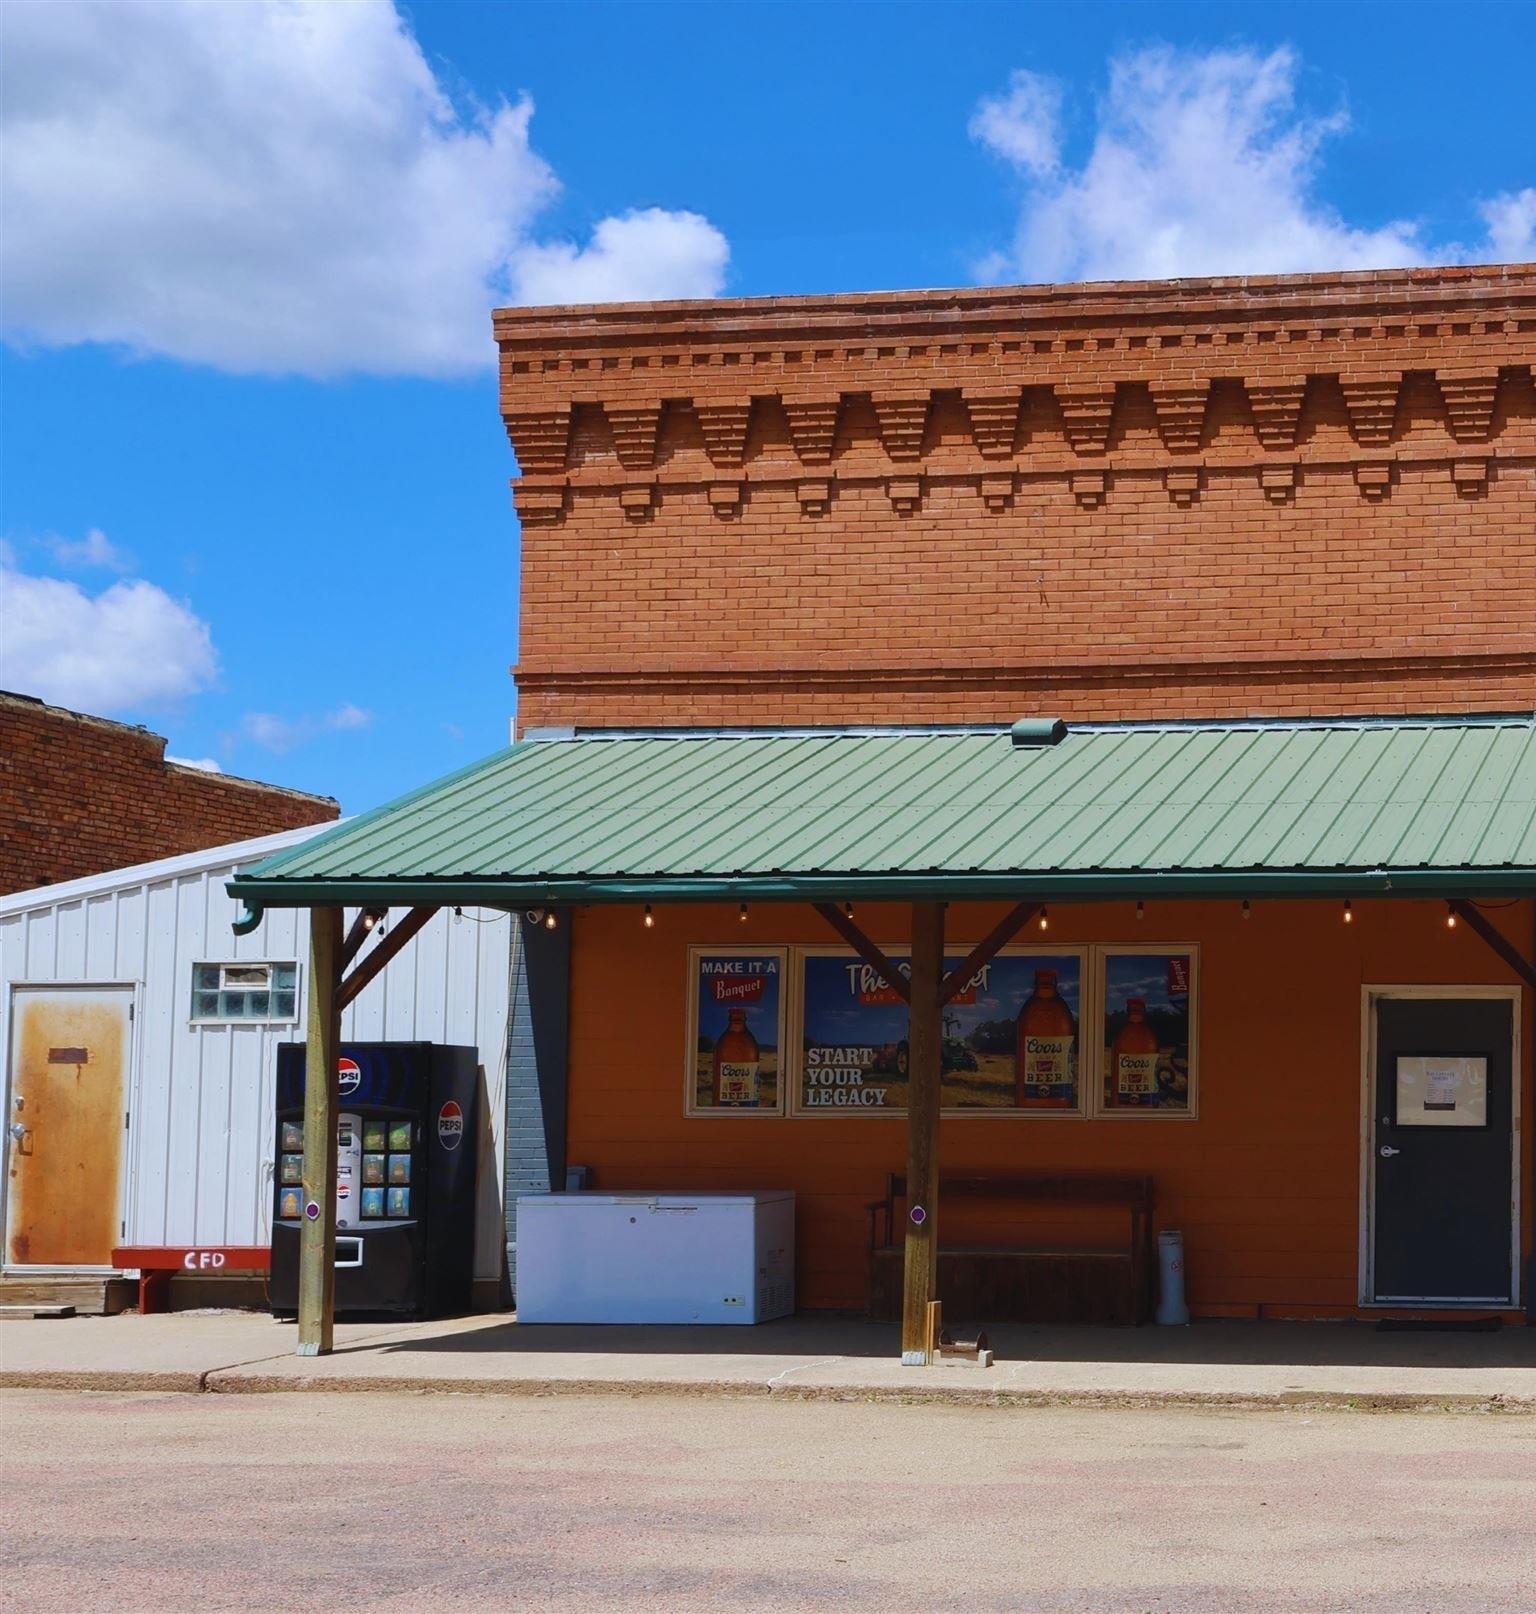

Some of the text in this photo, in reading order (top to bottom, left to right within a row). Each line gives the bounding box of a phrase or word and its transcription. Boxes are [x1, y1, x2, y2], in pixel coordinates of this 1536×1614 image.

[701, 962, 776, 973] MAKE IT A
[716, 980, 760, 999] Banquet
[1027, 1039, 1062, 1053] Coors
[808, 1047, 873, 1064] START
[1120, 1055, 1150, 1068] Coors
[722, 1065, 750, 1076] Coors
[808, 1068, 864, 1085] YOUR
[1027, 1073, 1062, 1082] BEER
[806, 1088, 887, 1106] LEGACY
[440, 1120, 462, 1131] PEPSI
[184, 1251, 225, 1269] CFD
